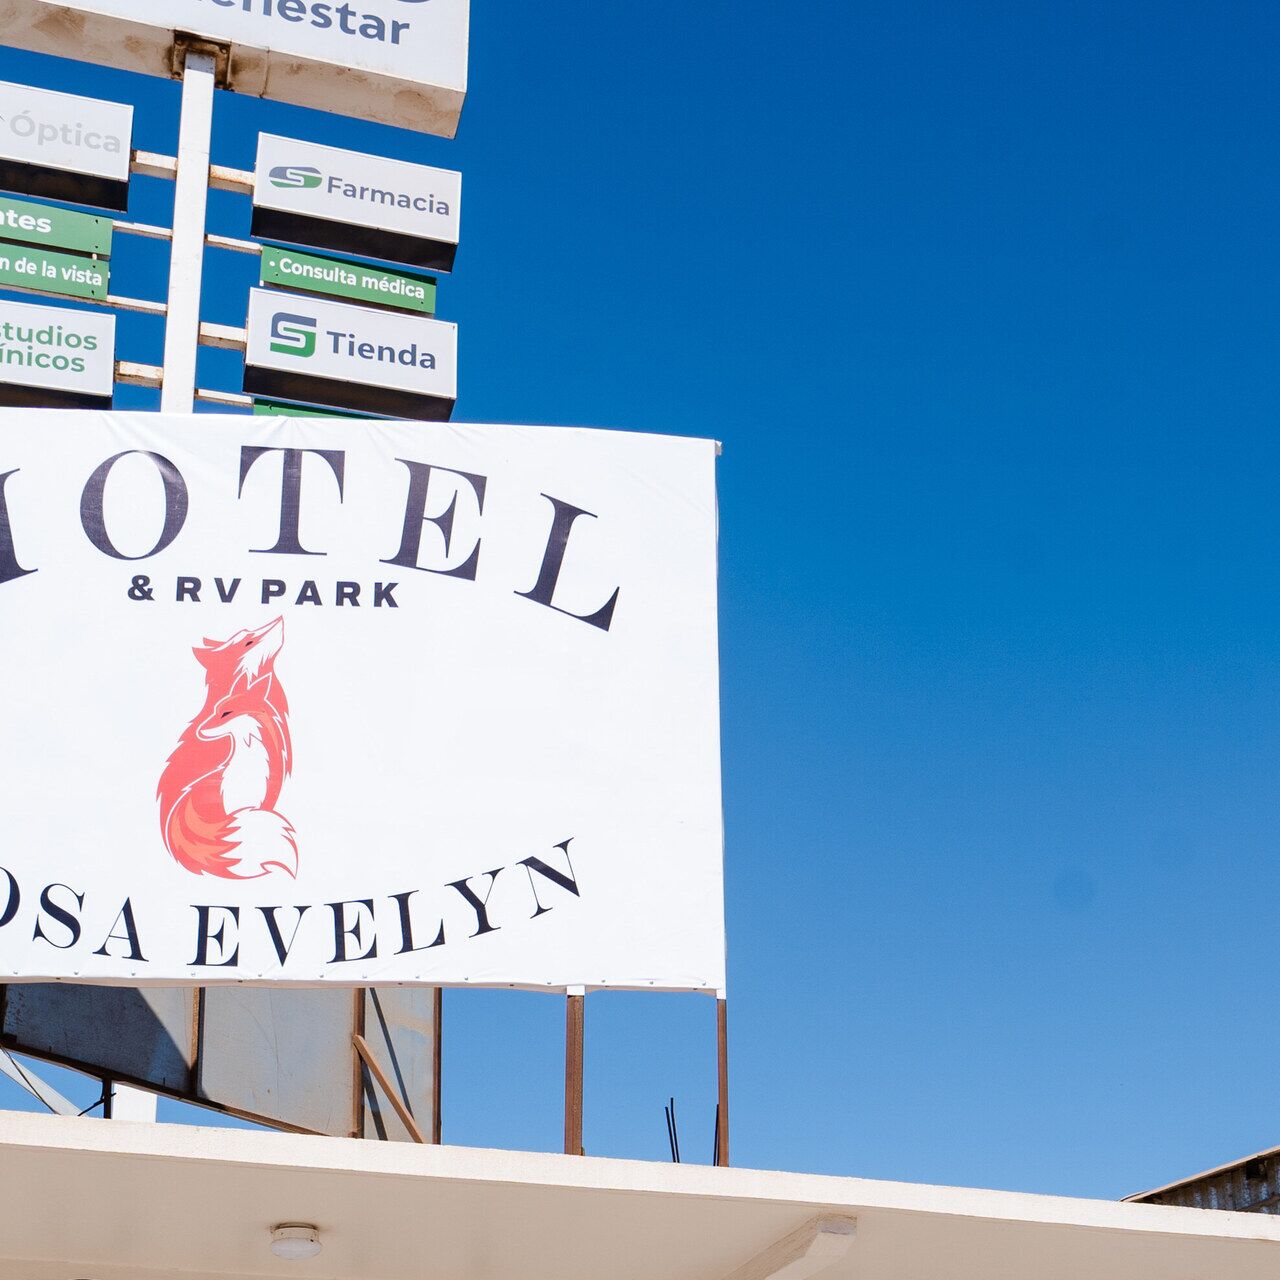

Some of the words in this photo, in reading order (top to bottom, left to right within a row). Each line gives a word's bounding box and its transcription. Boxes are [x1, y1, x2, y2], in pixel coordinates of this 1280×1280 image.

[211, 0, 410, 45] estar
[10, 110, 121, 153] Óptica
[327, 176, 450, 216] Farmacia
[14, 258, 37, 275] de
[42, 261, 56, 278] la
[61, 265, 102, 286] vista
[279, 258, 357, 286] Consulta
[362, 274, 425, 299] médica
[326, 330, 436, 370] Tienda
[127, 574, 155, 601] &
[177, 577, 242, 603] RV
[261, 579, 400, 608] PARK
[187, 838, 586, 968] EVELYN
